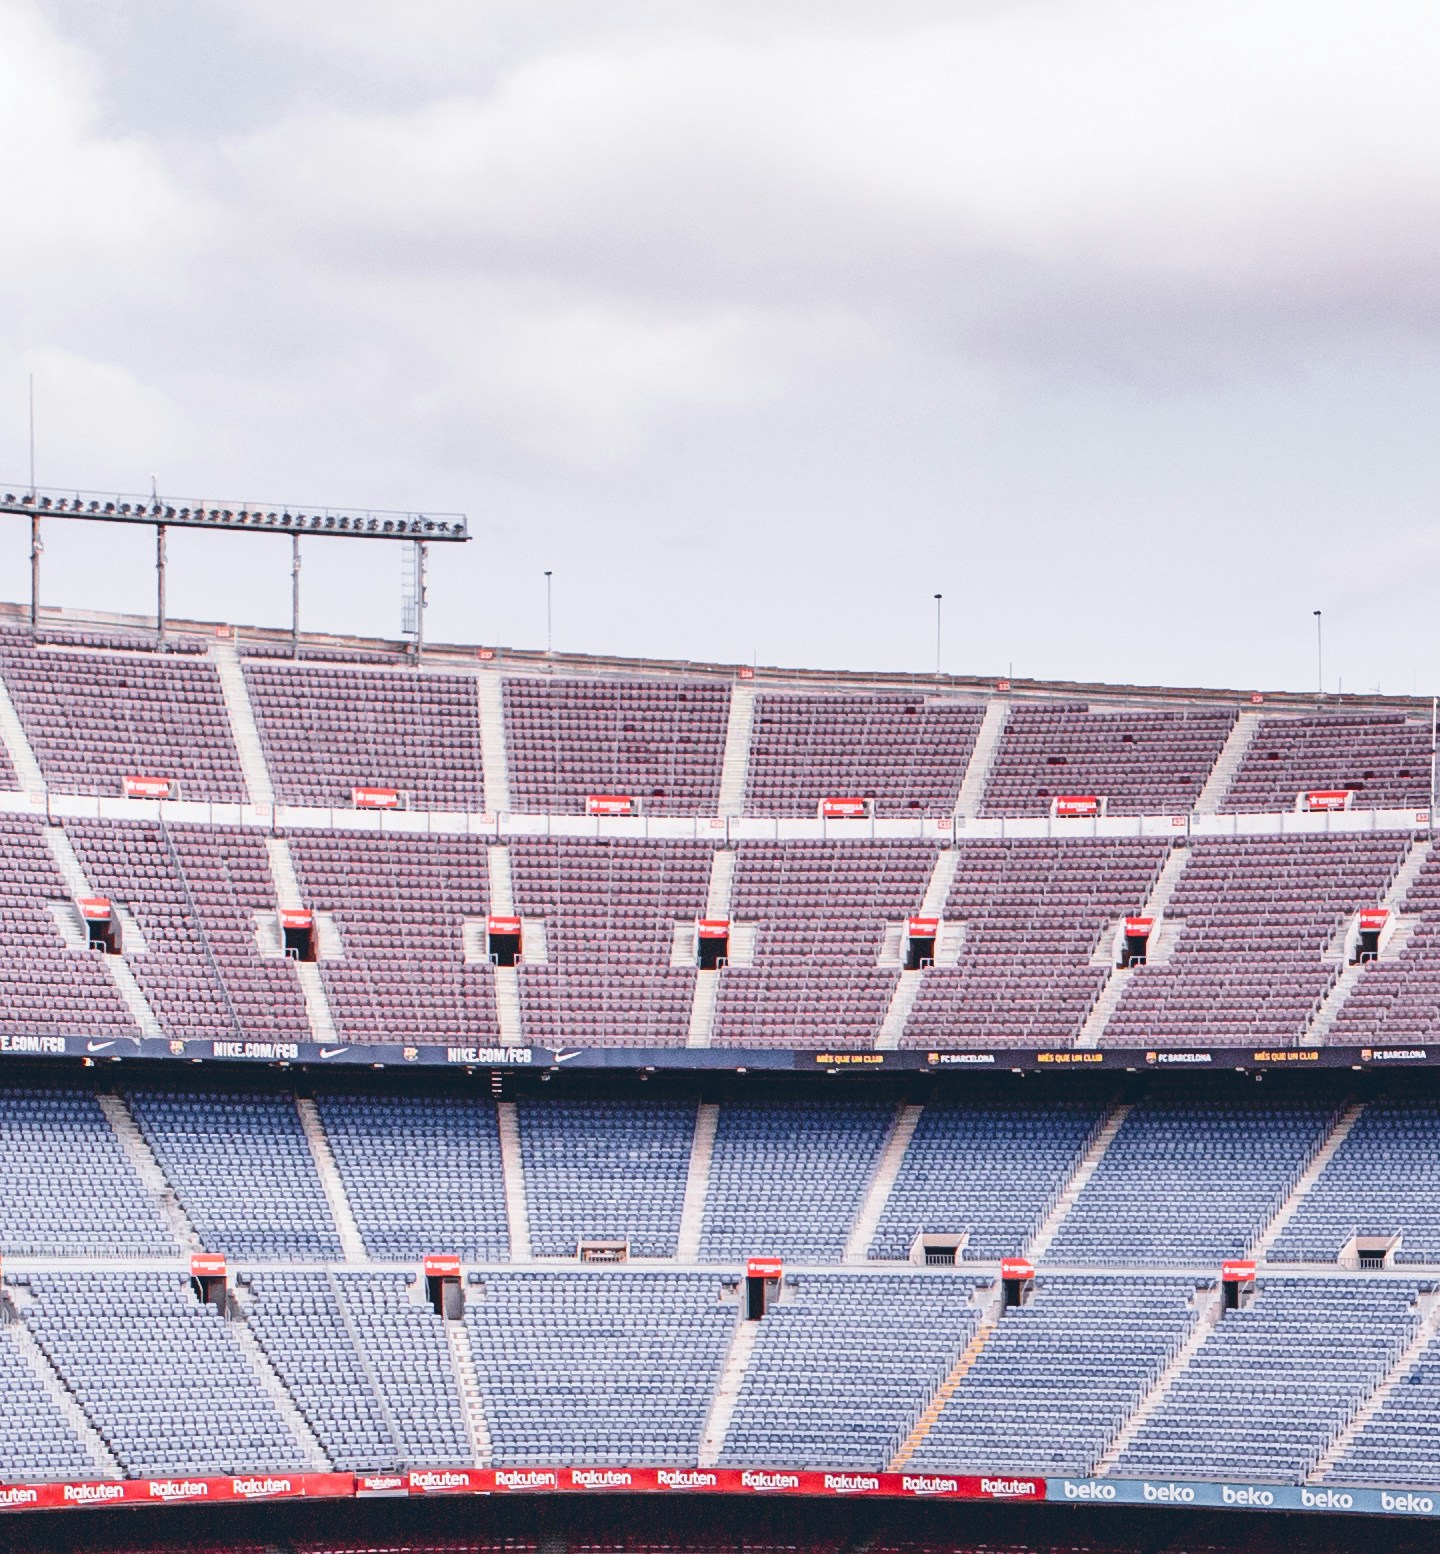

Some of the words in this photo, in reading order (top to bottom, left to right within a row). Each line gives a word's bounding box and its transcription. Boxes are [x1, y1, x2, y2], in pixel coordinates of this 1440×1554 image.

[214, 1042, 298, 1058] NIKE.COM/FCB
[447, 1046, 532, 1063] NIKE.COM/FCB
[940, 1055, 949, 1063] FC
[950, 1055, 994, 1063] BARCELONA
[1158, 1054, 1166, 1063] FC
[1168, 1053, 1211, 1063] BARCELONA
[1373, 1051, 1381, 1060] FC
[1383, 1050, 1426, 1060] BARCELONA
[363, 1478, 402, 1489] Rakuten
[410, 1472, 469, 1490] Rakuten
[496, 1471, 555, 1488] Rakuten
[573, 1470, 631, 1487] Rakuten
[658, 1471, 716, 1488] Rakuten
[742, 1473, 799, 1490] Rakuten
[824, 1474, 879, 1492] Rakuten
[902, 1476, 958, 1494] Rakuten
[65, 1484, 123, 1503] Rakuten
[150, 1481, 207, 1500] Rakuten
[233, 1479, 291, 1497] Rakuten
[982, 1479, 1035, 1497] Rakuten
[1065, 1481, 1115, 1499] beko
[1144, 1483, 1194, 1501] beko
[1223, 1486, 1273, 1505] beko
[1302, 1489, 1352, 1508] beko
[1382, 1492, 1433, 1512] beko
